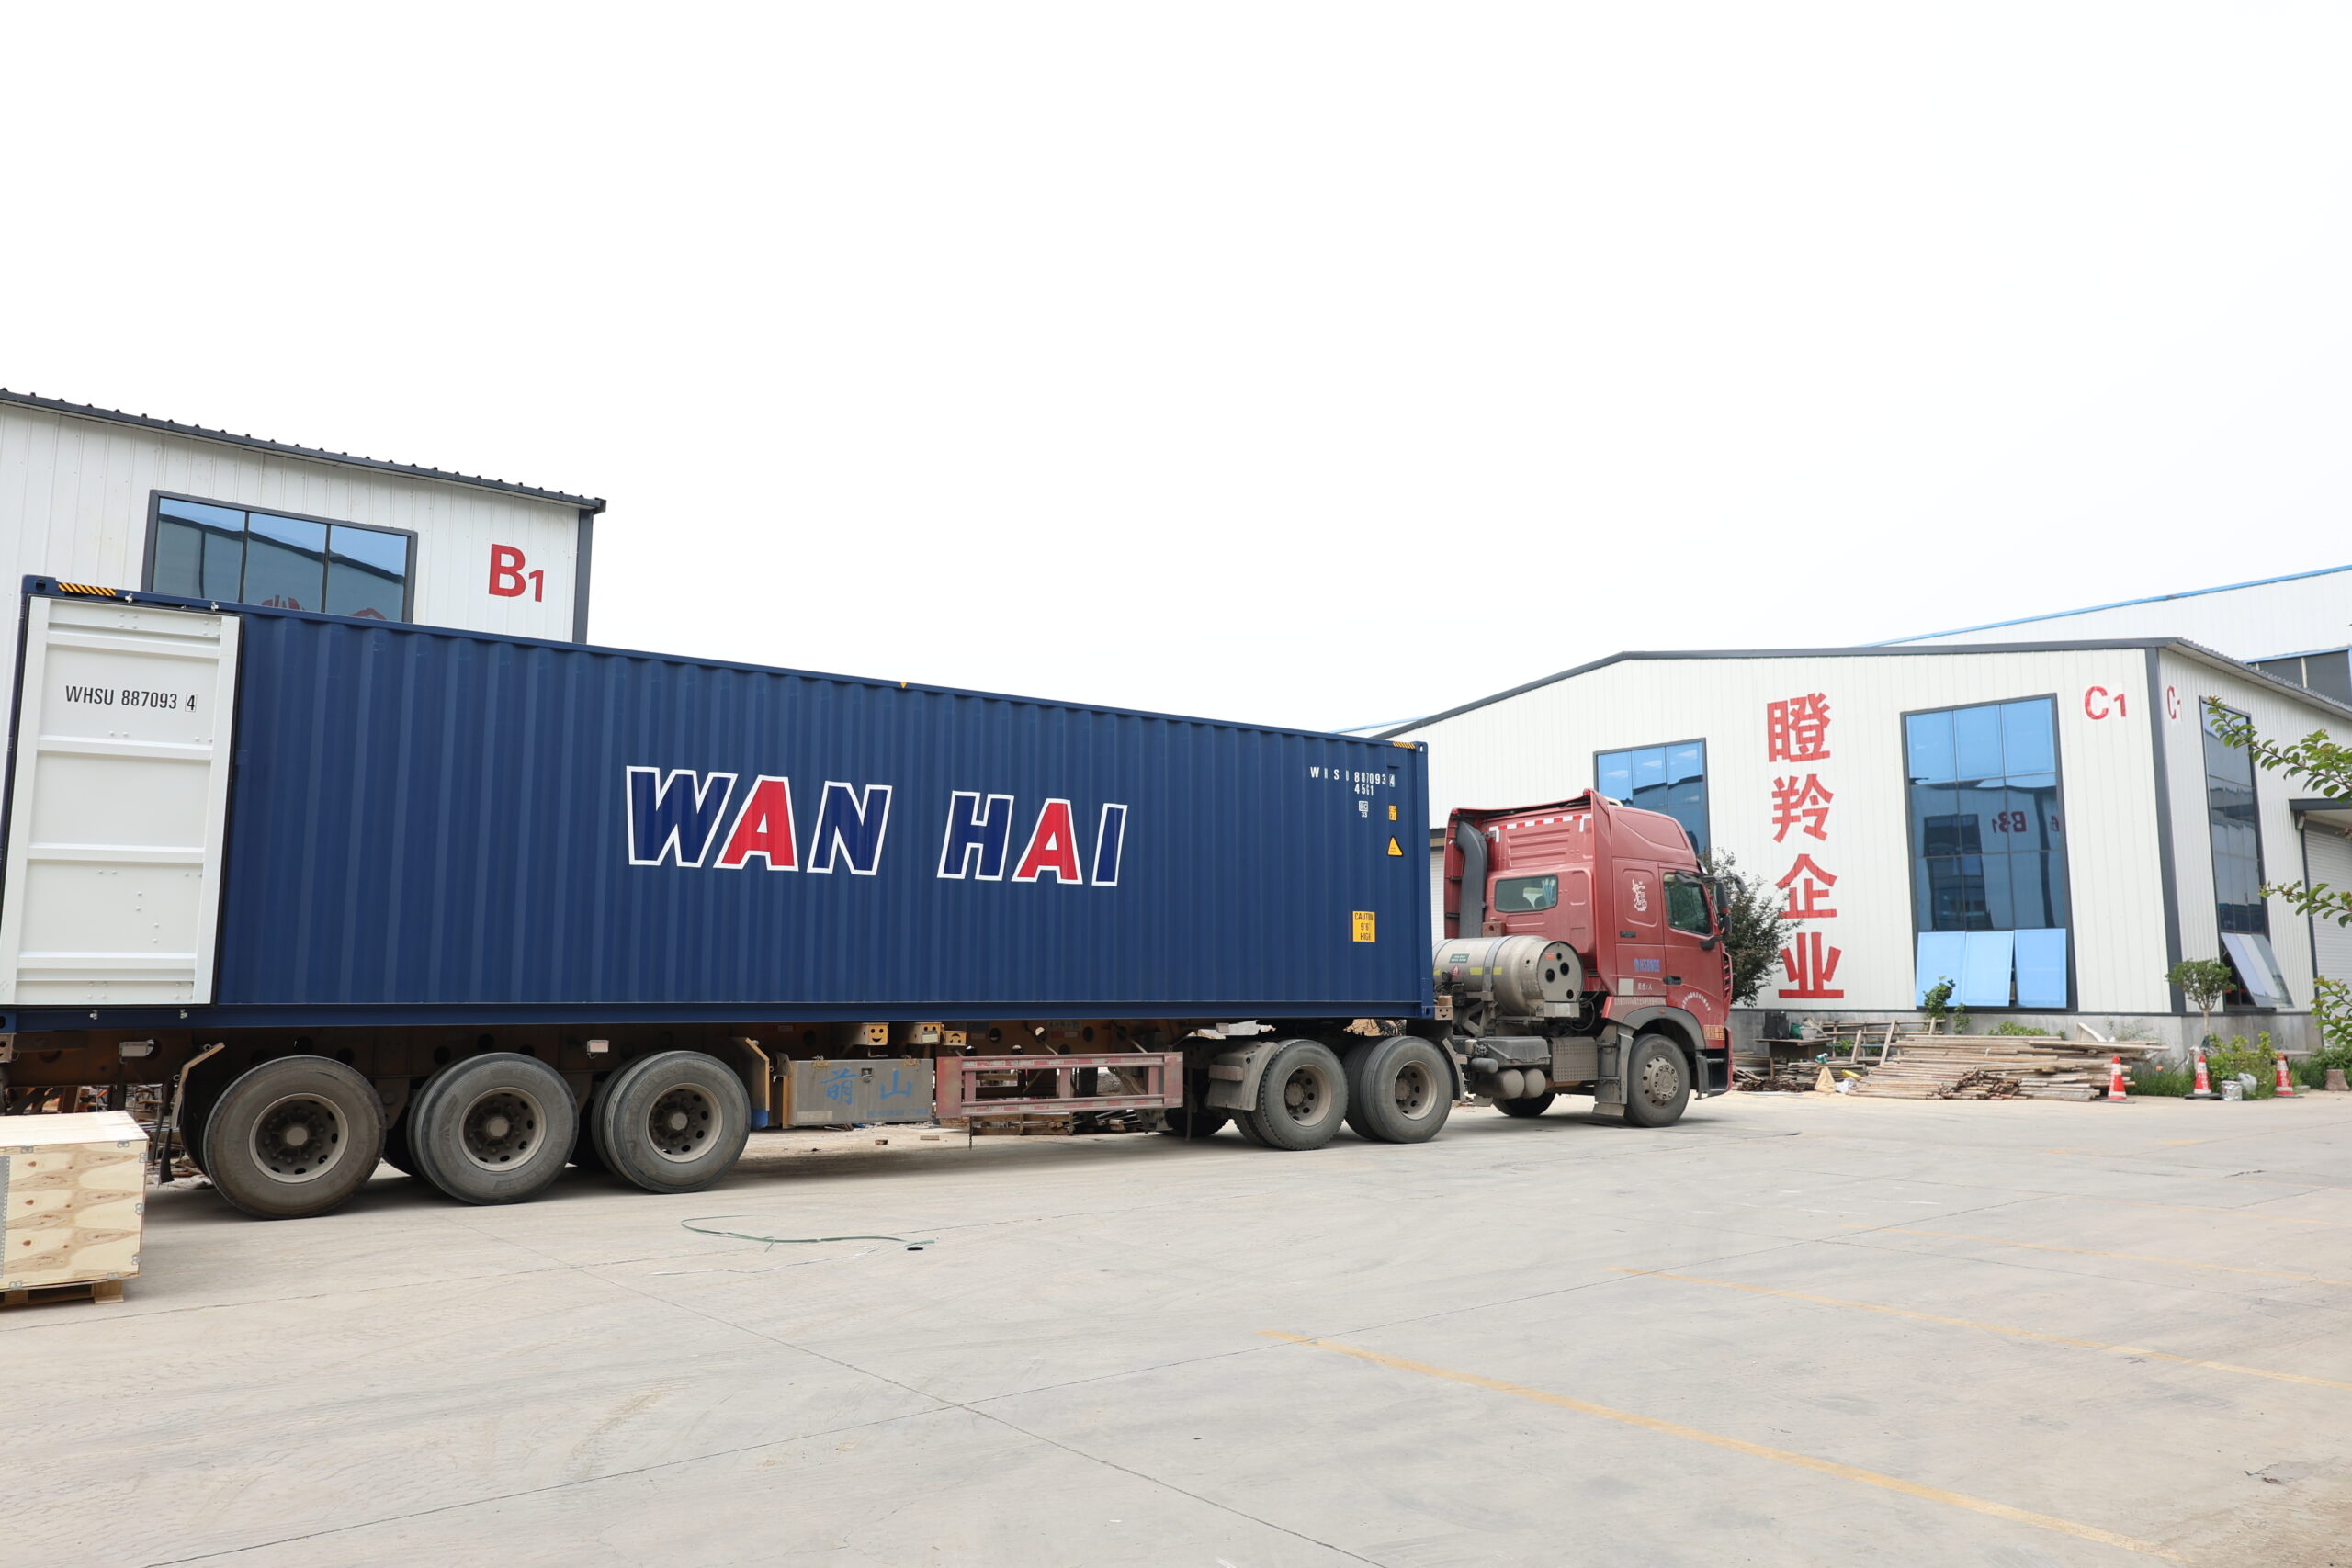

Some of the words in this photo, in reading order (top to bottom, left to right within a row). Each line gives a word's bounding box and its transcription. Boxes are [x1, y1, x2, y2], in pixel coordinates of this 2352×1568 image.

[488, 543, 544, 602] B1
[65, 684, 115, 705] WHSU
[120, 689, 178, 710] 887093
[186, 694, 197, 712] 4
[2085, 685, 2127, 720] C1
[626, 765, 893, 876] WAN
[936, 790, 1128, 887] HAI
[1767, 693, 1845, 999] 瞪羚企业
